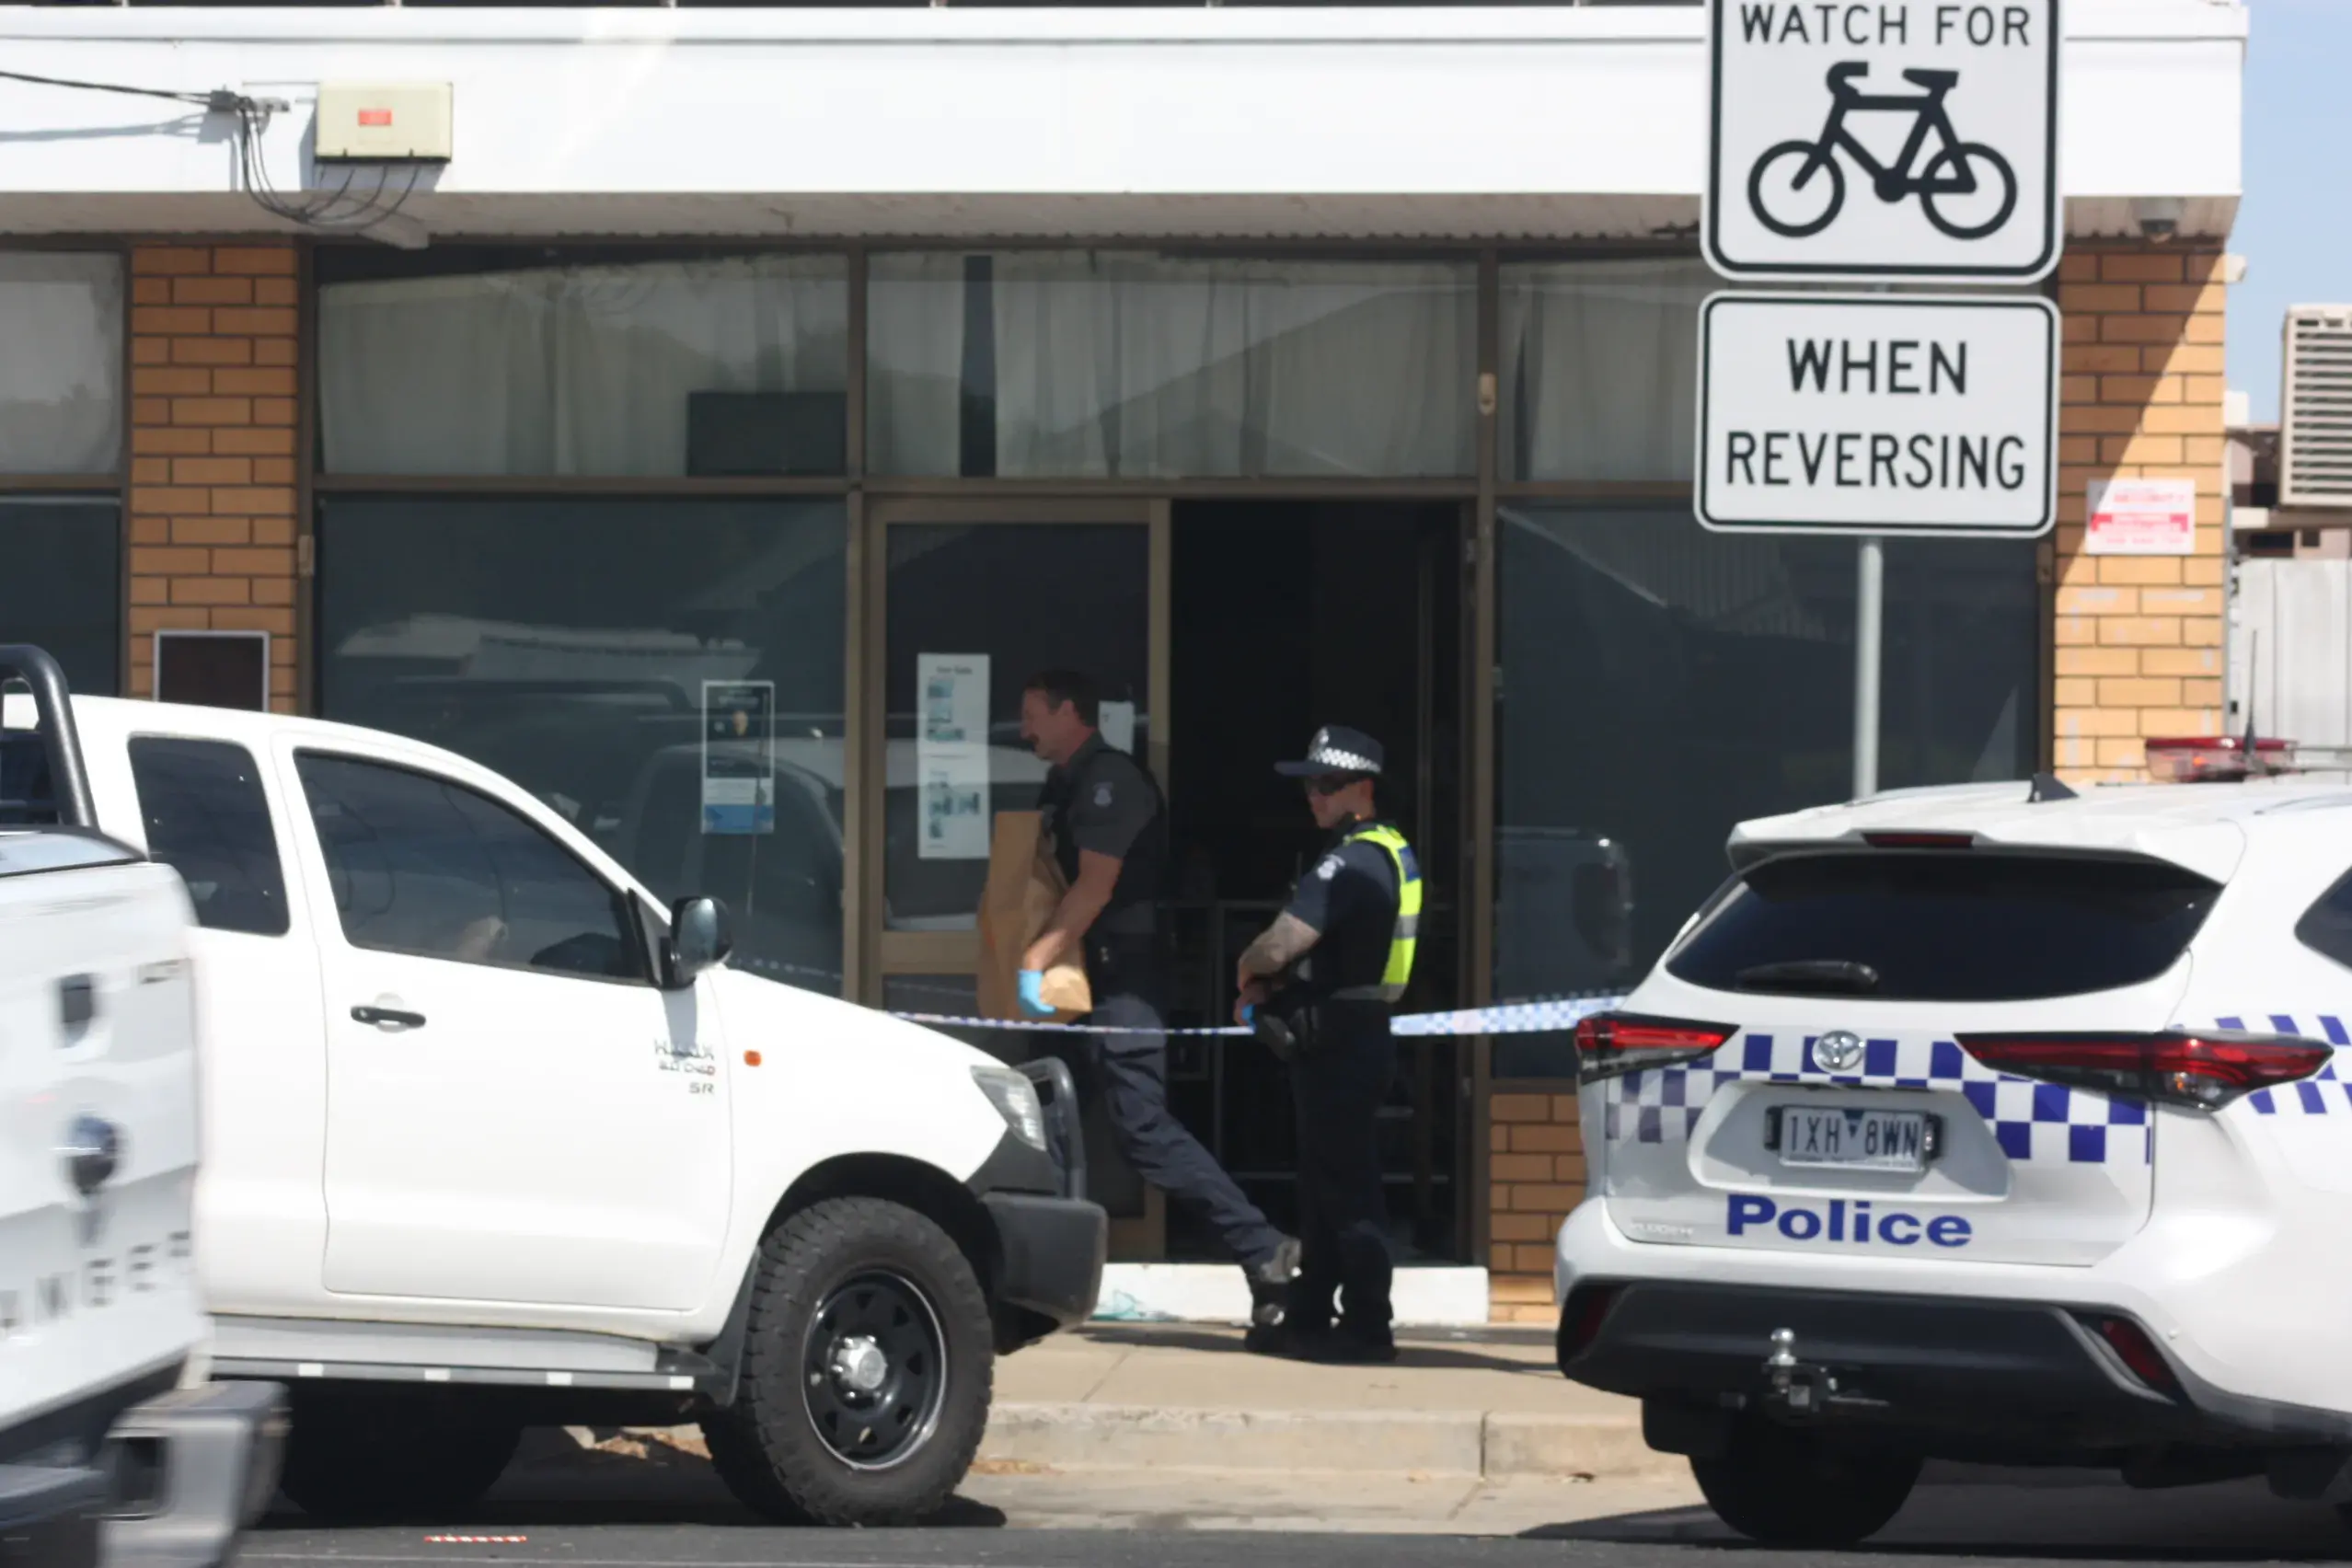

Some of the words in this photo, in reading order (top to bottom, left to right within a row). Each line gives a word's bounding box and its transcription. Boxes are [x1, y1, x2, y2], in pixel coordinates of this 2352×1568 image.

[1740, 4, 1907, 45] WATCH
[1935, 5, 2031, 47] FOR
[1787, 338, 1967, 396] WHEN
[1726, 431, 2025, 490] REVERSING
[1726, 1193, 1973, 1249] Police
